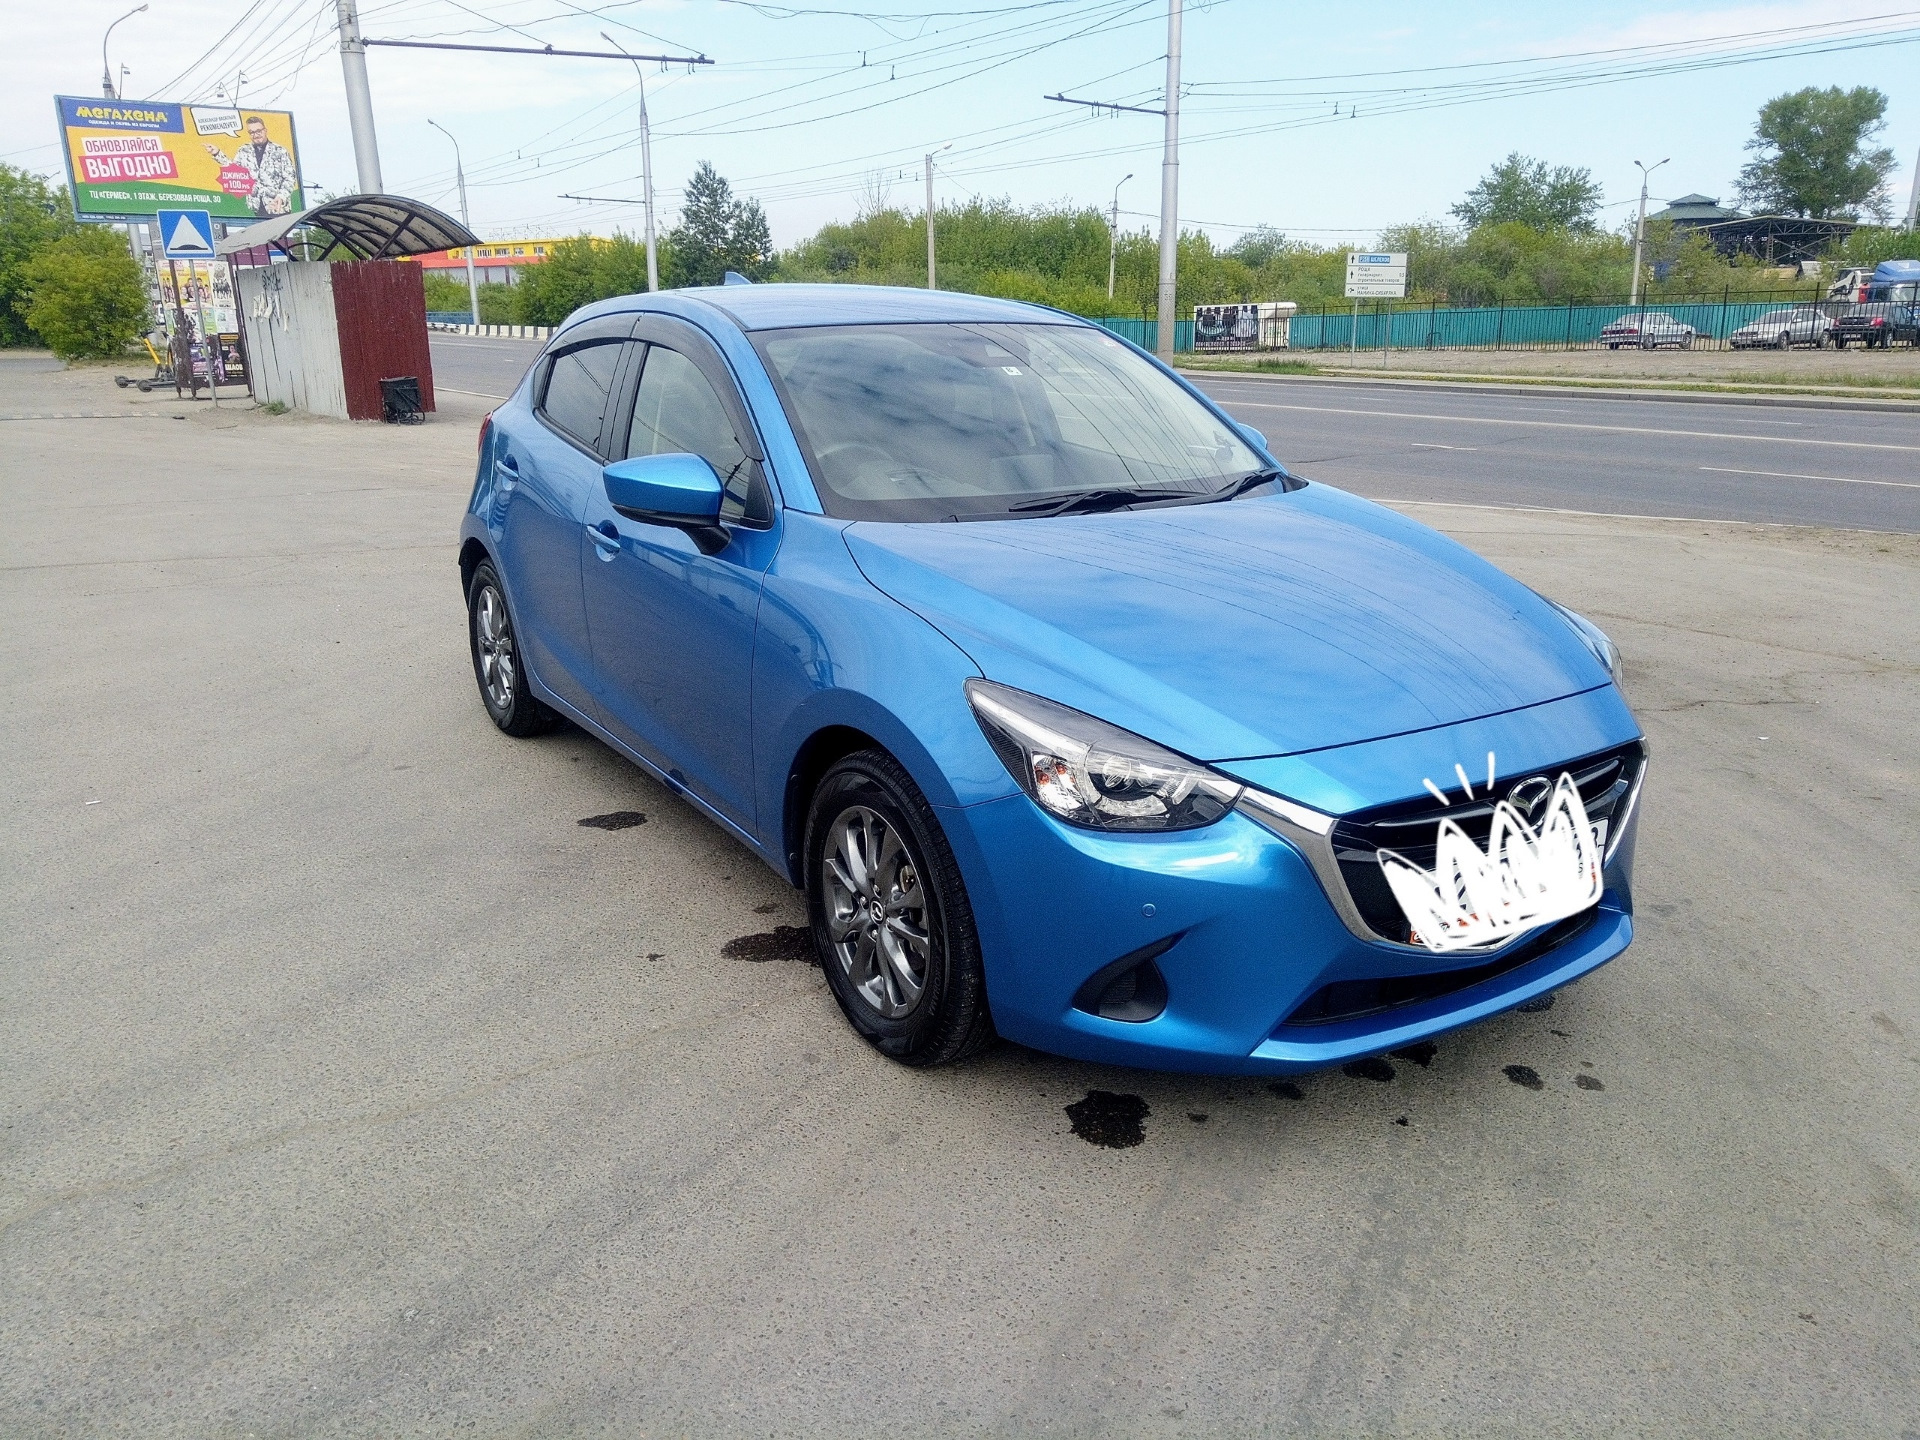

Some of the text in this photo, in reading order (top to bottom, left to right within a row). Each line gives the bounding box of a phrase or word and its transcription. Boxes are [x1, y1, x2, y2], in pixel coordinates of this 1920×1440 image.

[85, 138, 159, 152] ОБНОВЛЯЙСЯ
[85, 155, 172, 178] ВЫГОДНО
[229, 180, 242, 189] 100
[89, 190, 100, 199] ТЦ
[158, 194, 192, 202] БЕРЕЗОВАЯ
